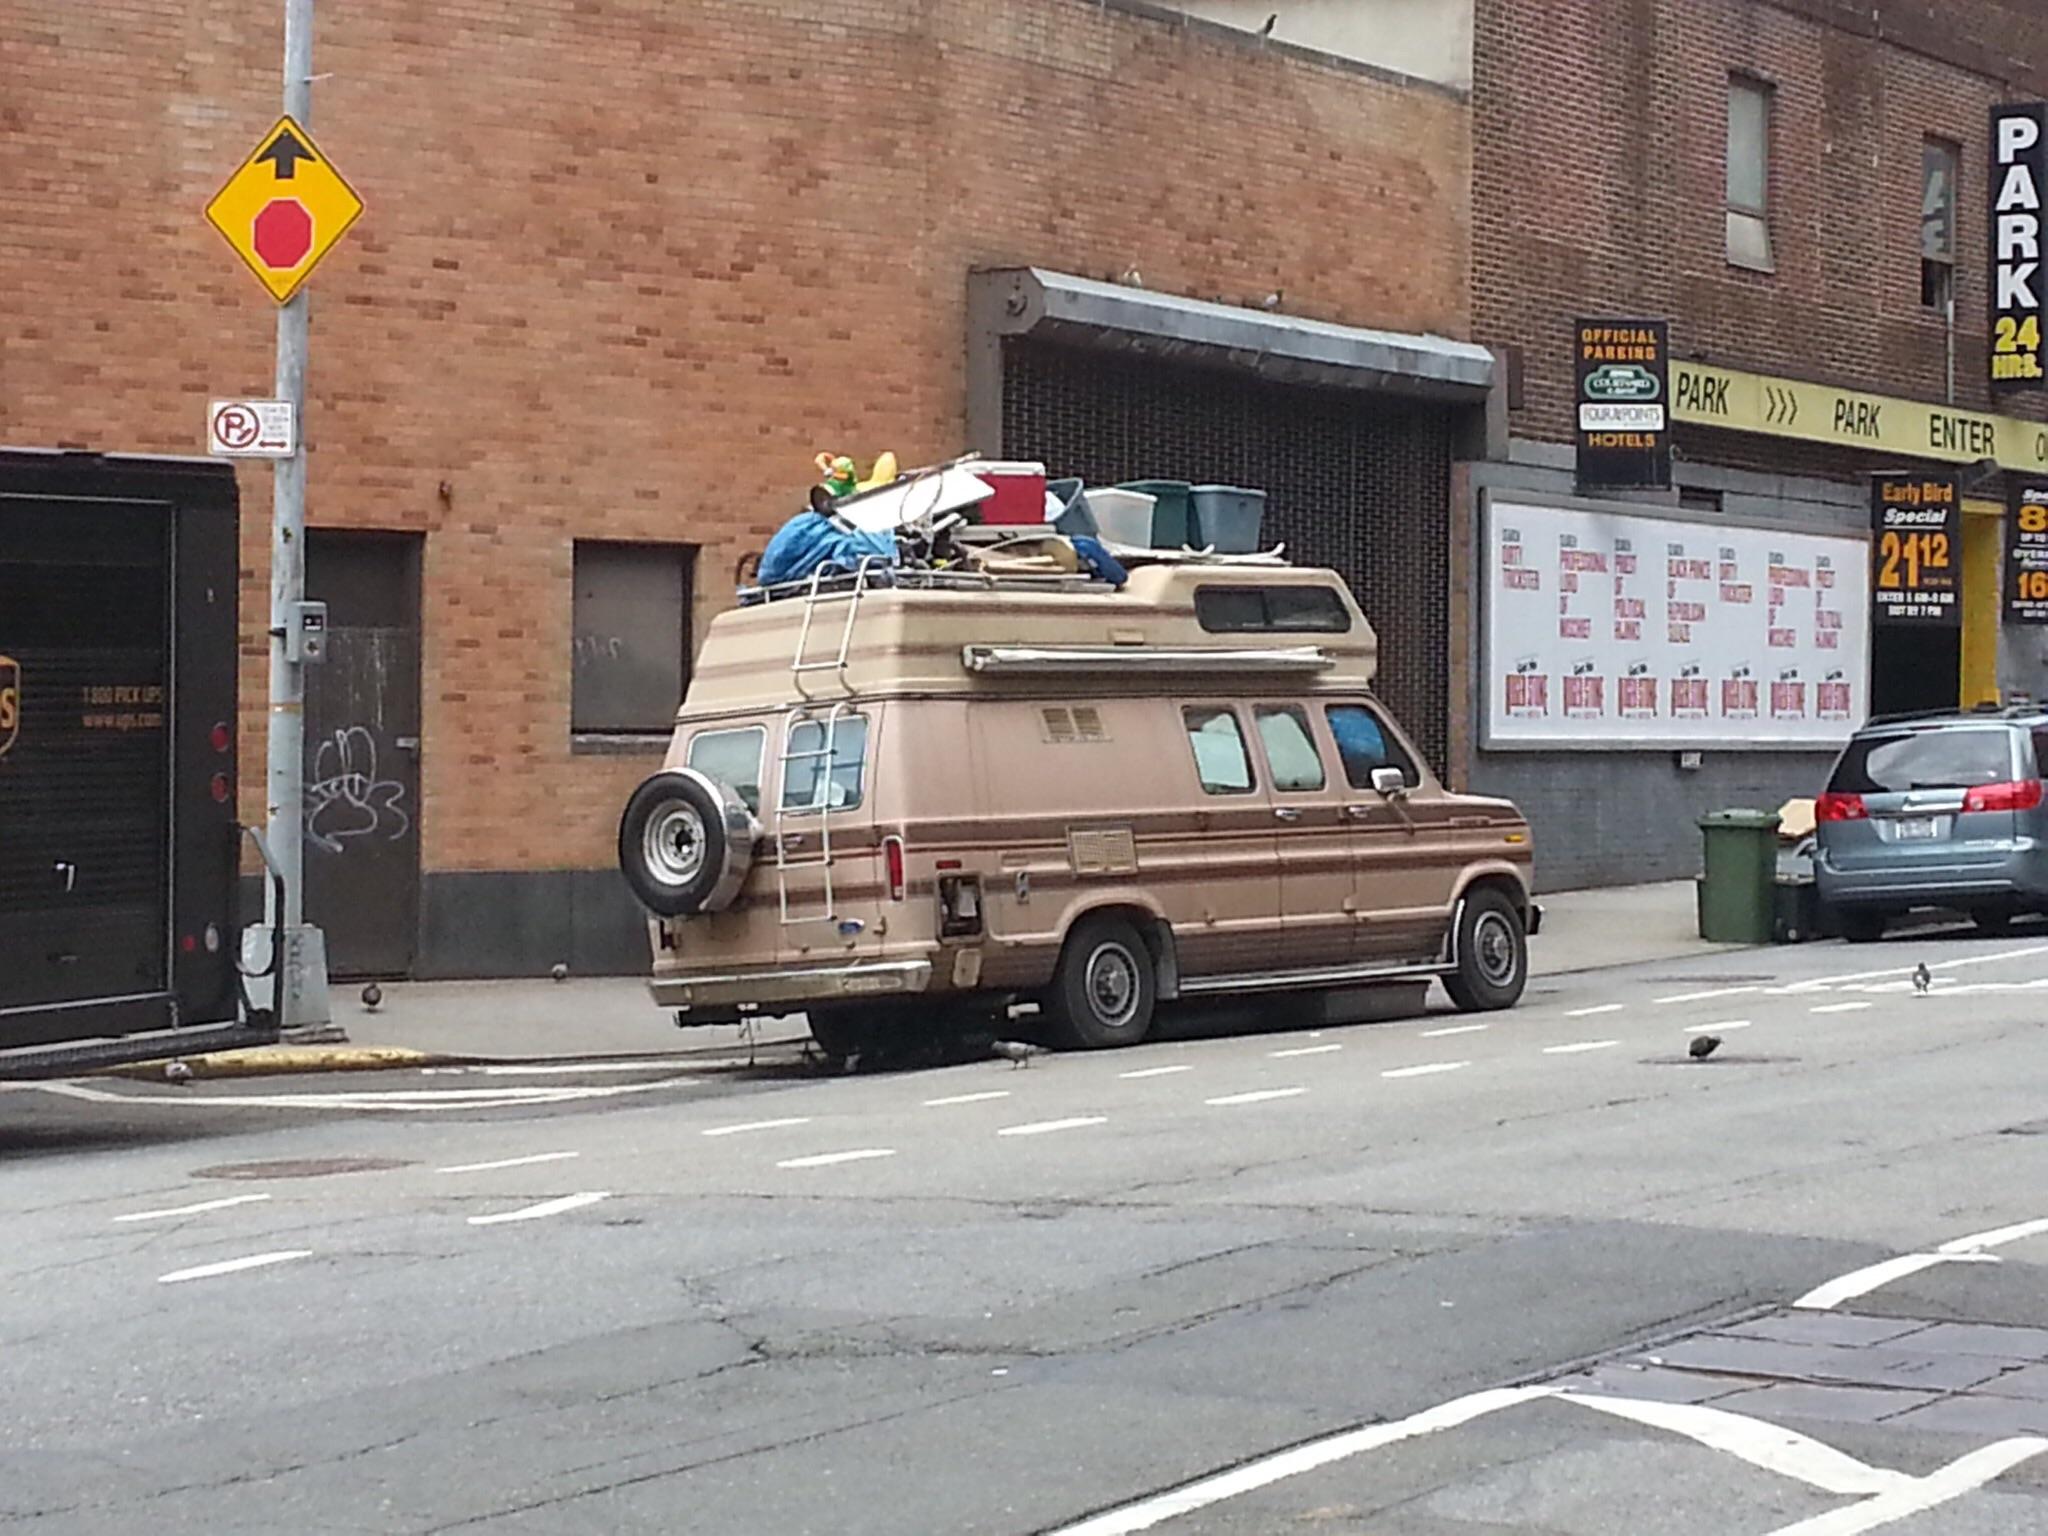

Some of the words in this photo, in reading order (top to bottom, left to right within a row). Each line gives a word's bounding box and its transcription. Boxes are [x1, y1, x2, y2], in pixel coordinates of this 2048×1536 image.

[1996, 117, 2039, 309] PARK
[1581, 328, 1658, 344] OFFICIAL
[1995, 316, 2040, 352] 24
[1583, 346, 1656, 360] PARKING
[1675, 371, 1730, 415] PARK
[1833, 398, 1881, 439] PARK
[1588, 433, 1656, 448] HOTELS
[1929, 413, 1995, 455] ENTER
[1882, 482, 1920, 505] Early
[1923, 482, 1953, 502] Bird
[1884, 507, 1948, 525] Special
